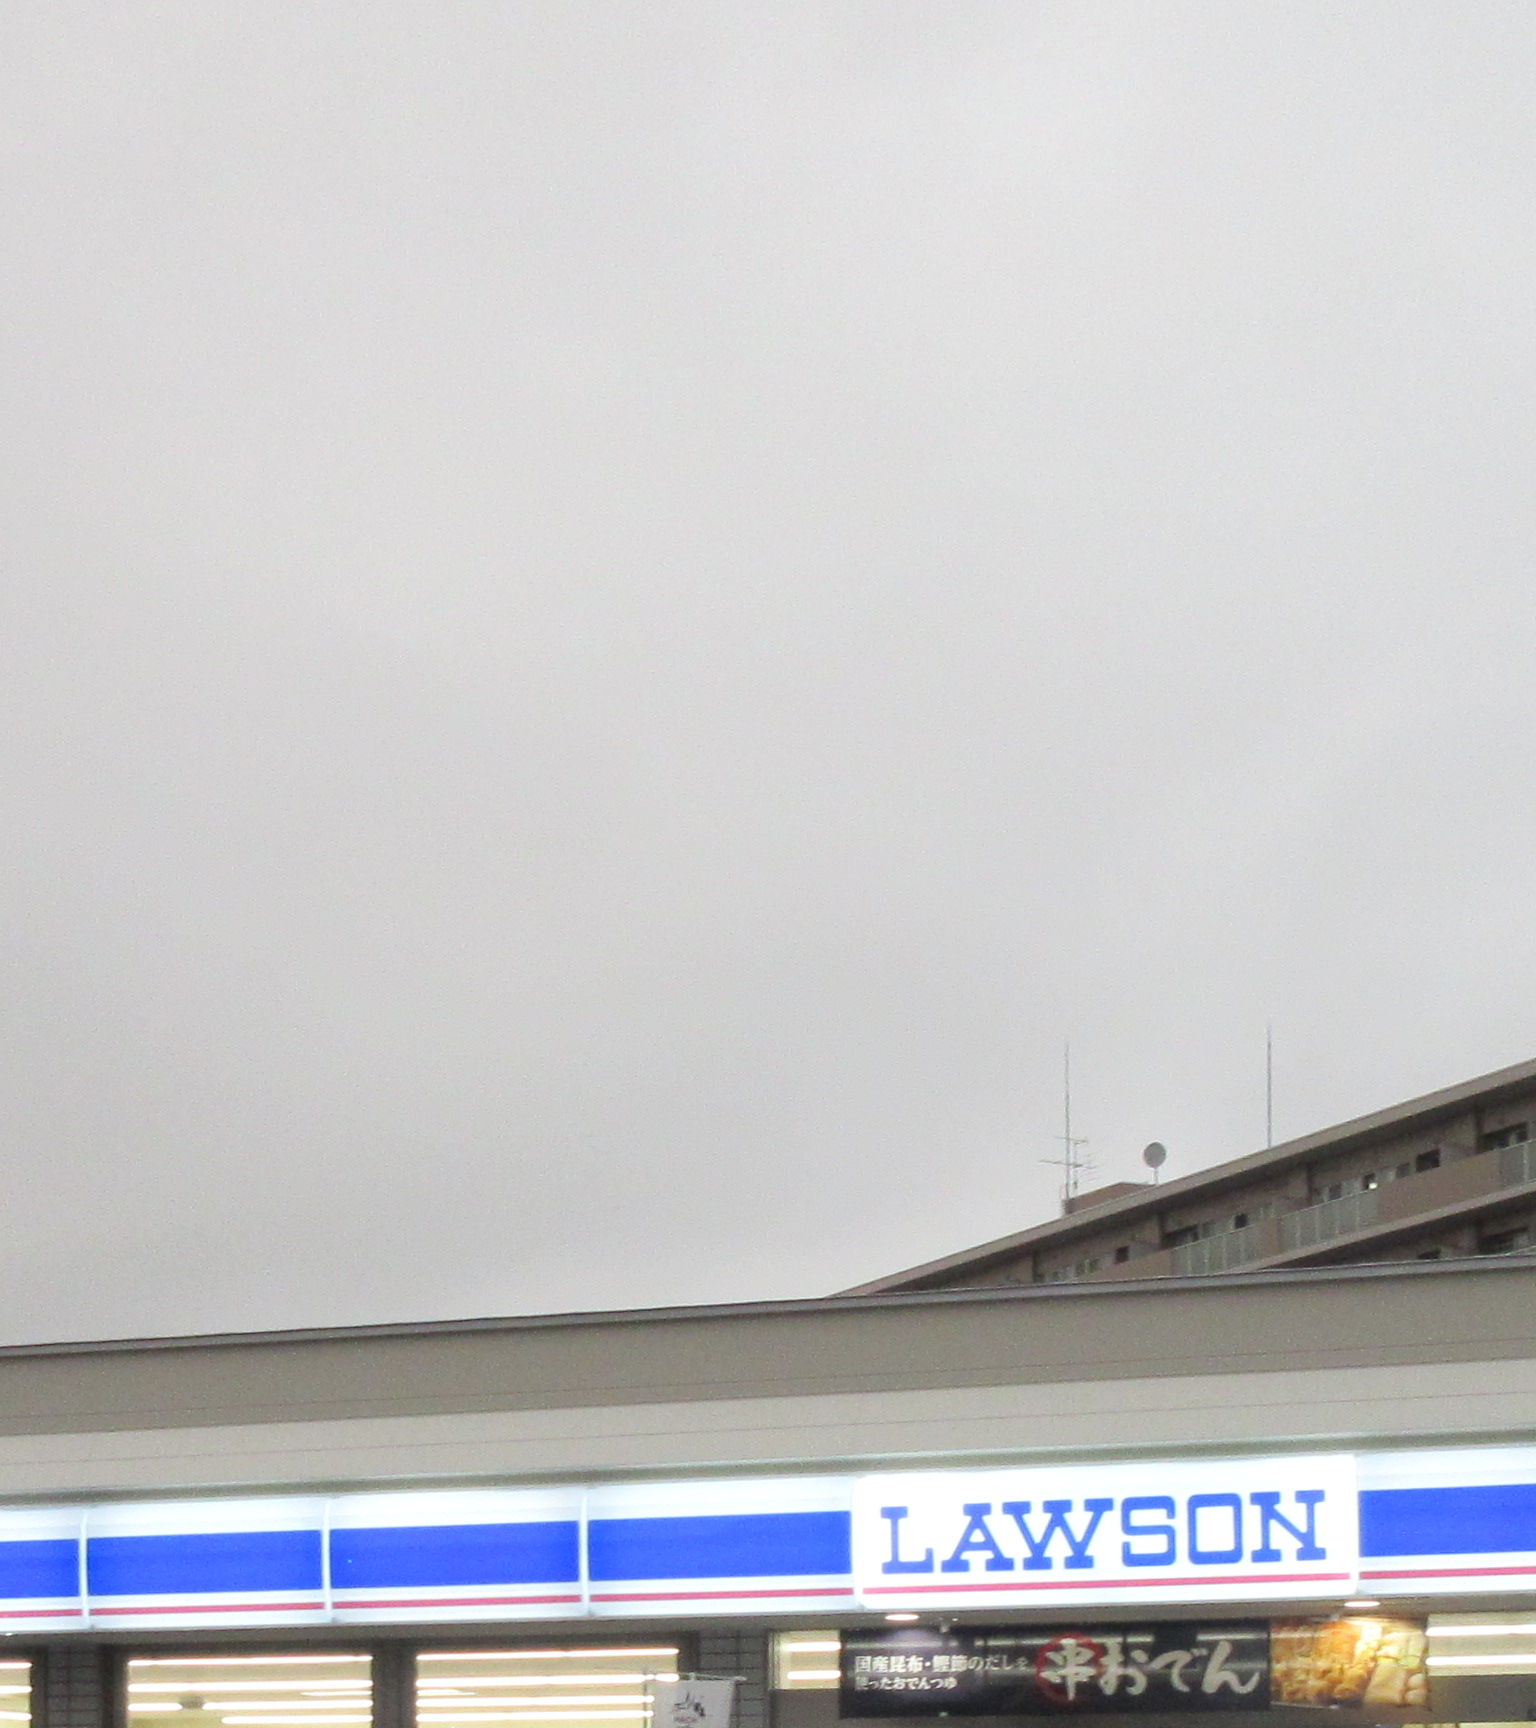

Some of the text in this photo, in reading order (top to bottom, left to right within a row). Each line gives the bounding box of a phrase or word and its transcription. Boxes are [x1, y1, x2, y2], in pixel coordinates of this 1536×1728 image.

[880, 1489, 1327, 1575] LAWSON
[1040, 1638, 1261, 1701] 串おでん
